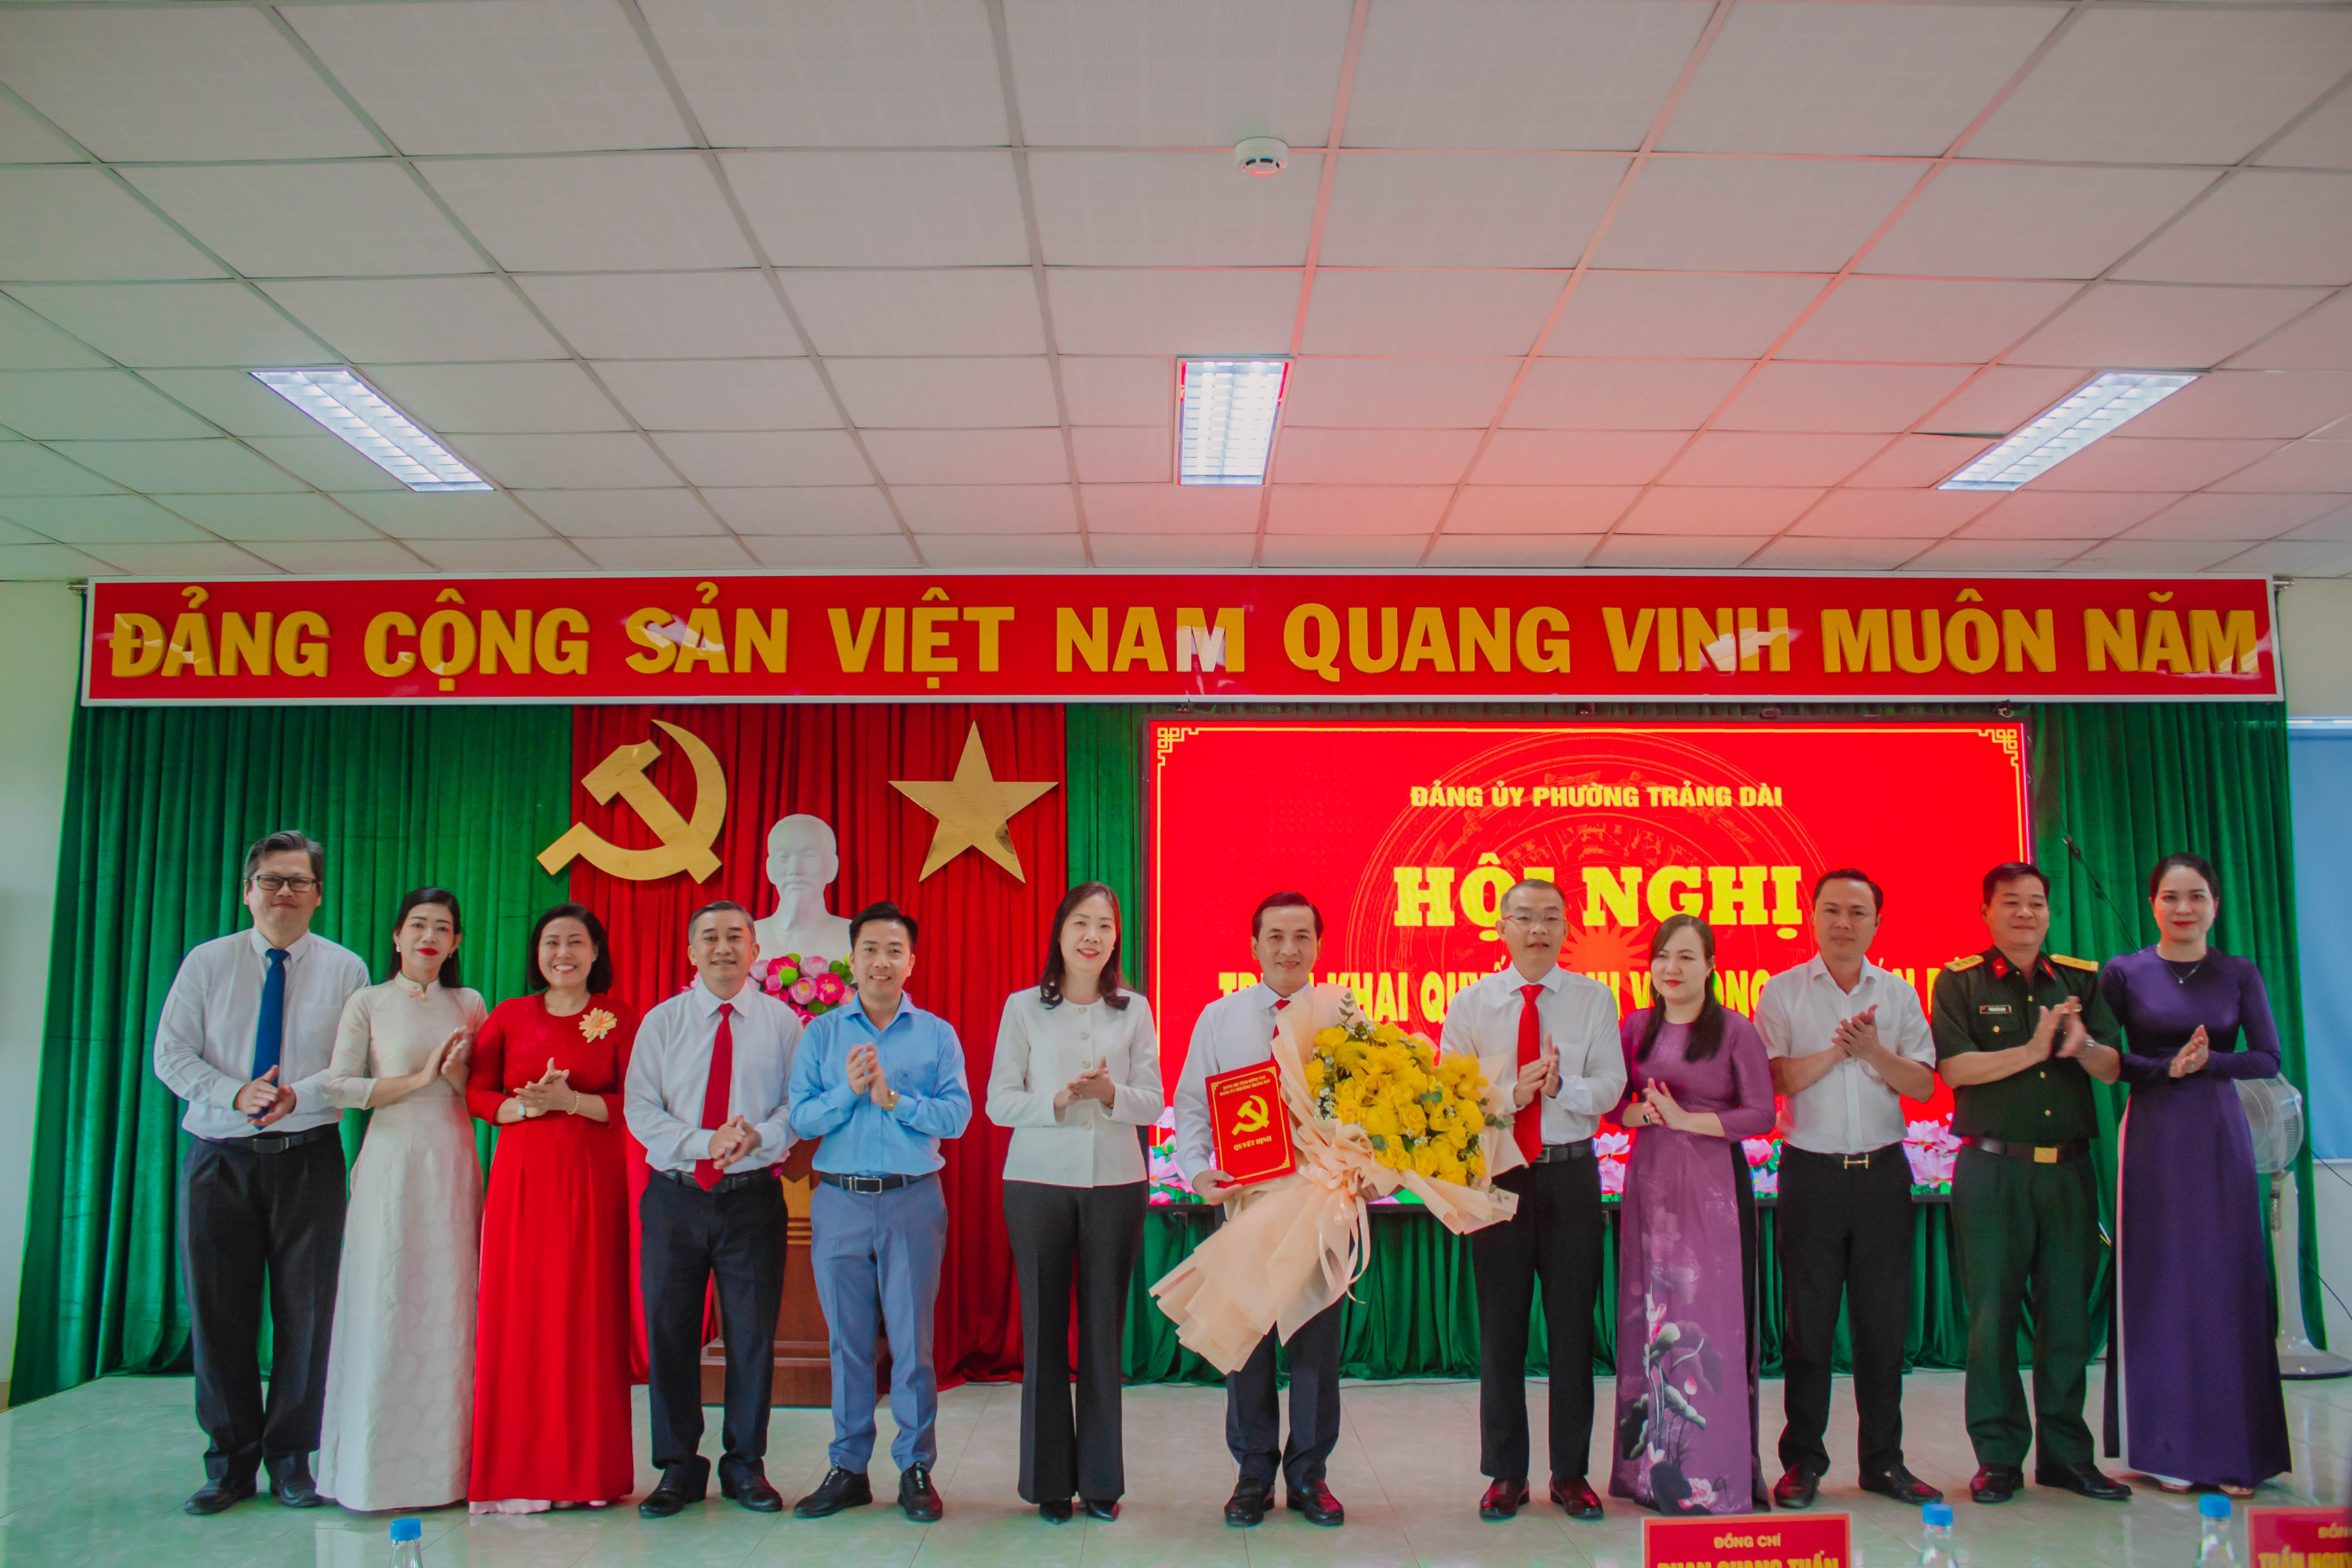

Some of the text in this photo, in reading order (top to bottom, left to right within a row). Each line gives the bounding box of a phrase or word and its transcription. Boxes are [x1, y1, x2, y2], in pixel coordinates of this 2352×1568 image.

[109, 582, 2259, 691] ĐẢNG CỘNG SẢN VIỆT NAM QUANG VINH MUÔN NĂM
[1410, 780, 1783, 808] ĐẢNG ỦY PHƯỜNG TRẢNG DÀI
[1393, 852, 1802, 942] HỘ NGHỊ
[1757, 1533, 1781, 1548] CHÍ
